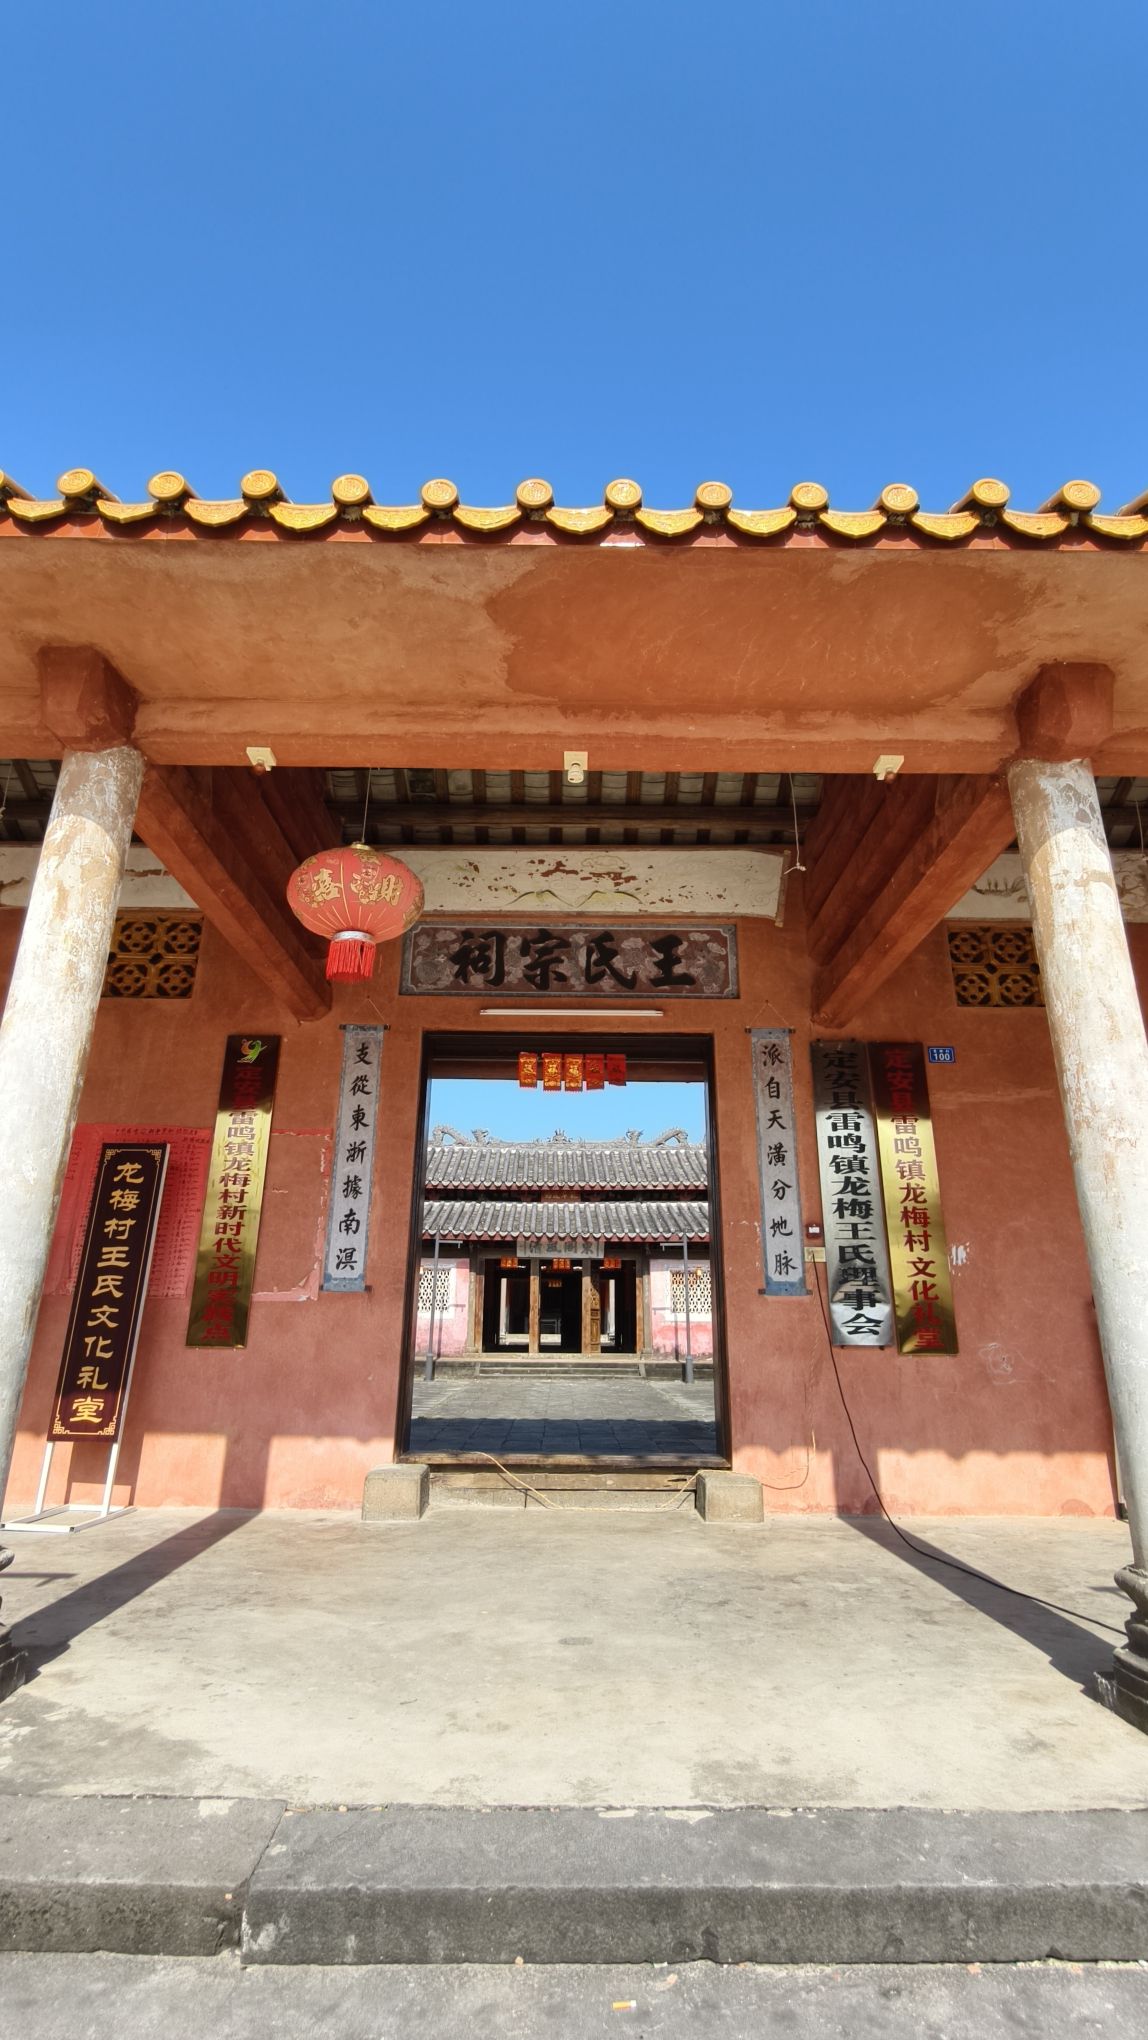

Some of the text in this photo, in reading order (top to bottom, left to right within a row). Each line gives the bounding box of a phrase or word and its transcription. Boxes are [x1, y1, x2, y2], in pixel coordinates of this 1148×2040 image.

[823, 1050, 884, 1336] 定安县雷鸣镇龙梅王氏理事会
[933, 1053, 951, 1061] 100
[69, 1161, 145, 1423] 龙梅村王氏文化礼堂
[885, 1049, 945, 1349] 定安县雷鸣镇龙梅村文化礼堂
